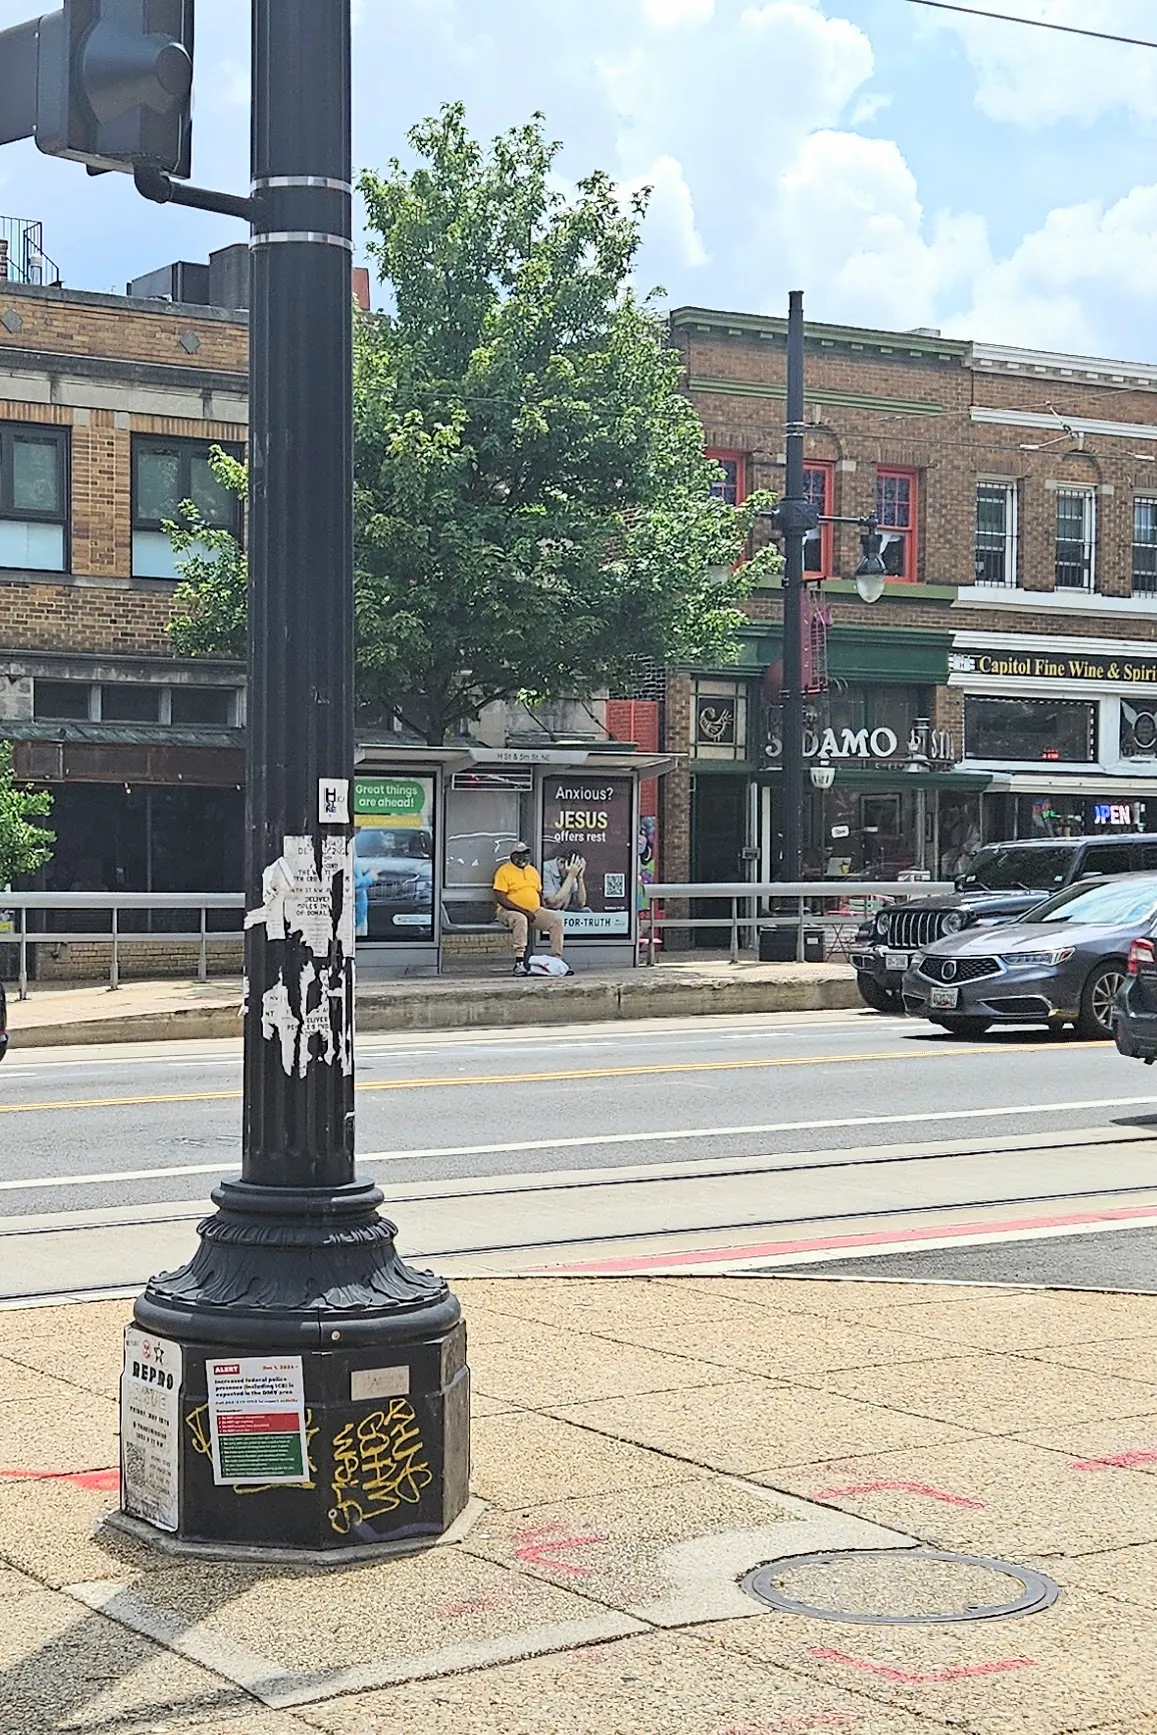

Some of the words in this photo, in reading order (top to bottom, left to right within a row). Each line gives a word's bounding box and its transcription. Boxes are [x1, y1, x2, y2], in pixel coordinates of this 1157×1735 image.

[979, 655, 1030, 676] Capitol
[1034, 660, 1065, 676] Fine
[1068, 660, 1104, 678] Wine
[1107, 662, 1120, 679] &
[765, 727, 897, 758] SDAMO
[355, 784, 384, 794] Great
[386, 784, 418, 798] things
[555, 786, 614, 800] Anxious?
[359, 799, 376, 807] are
[378, 797, 414, 808] ahead!
[554, 811, 608, 829] JESUS
[554, 830, 584, 842] offers
[586, 832, 606, 842] rest
[132, 1361, 174, 1390] REPRO
[214, 1366, 239, 1374] ALERT
